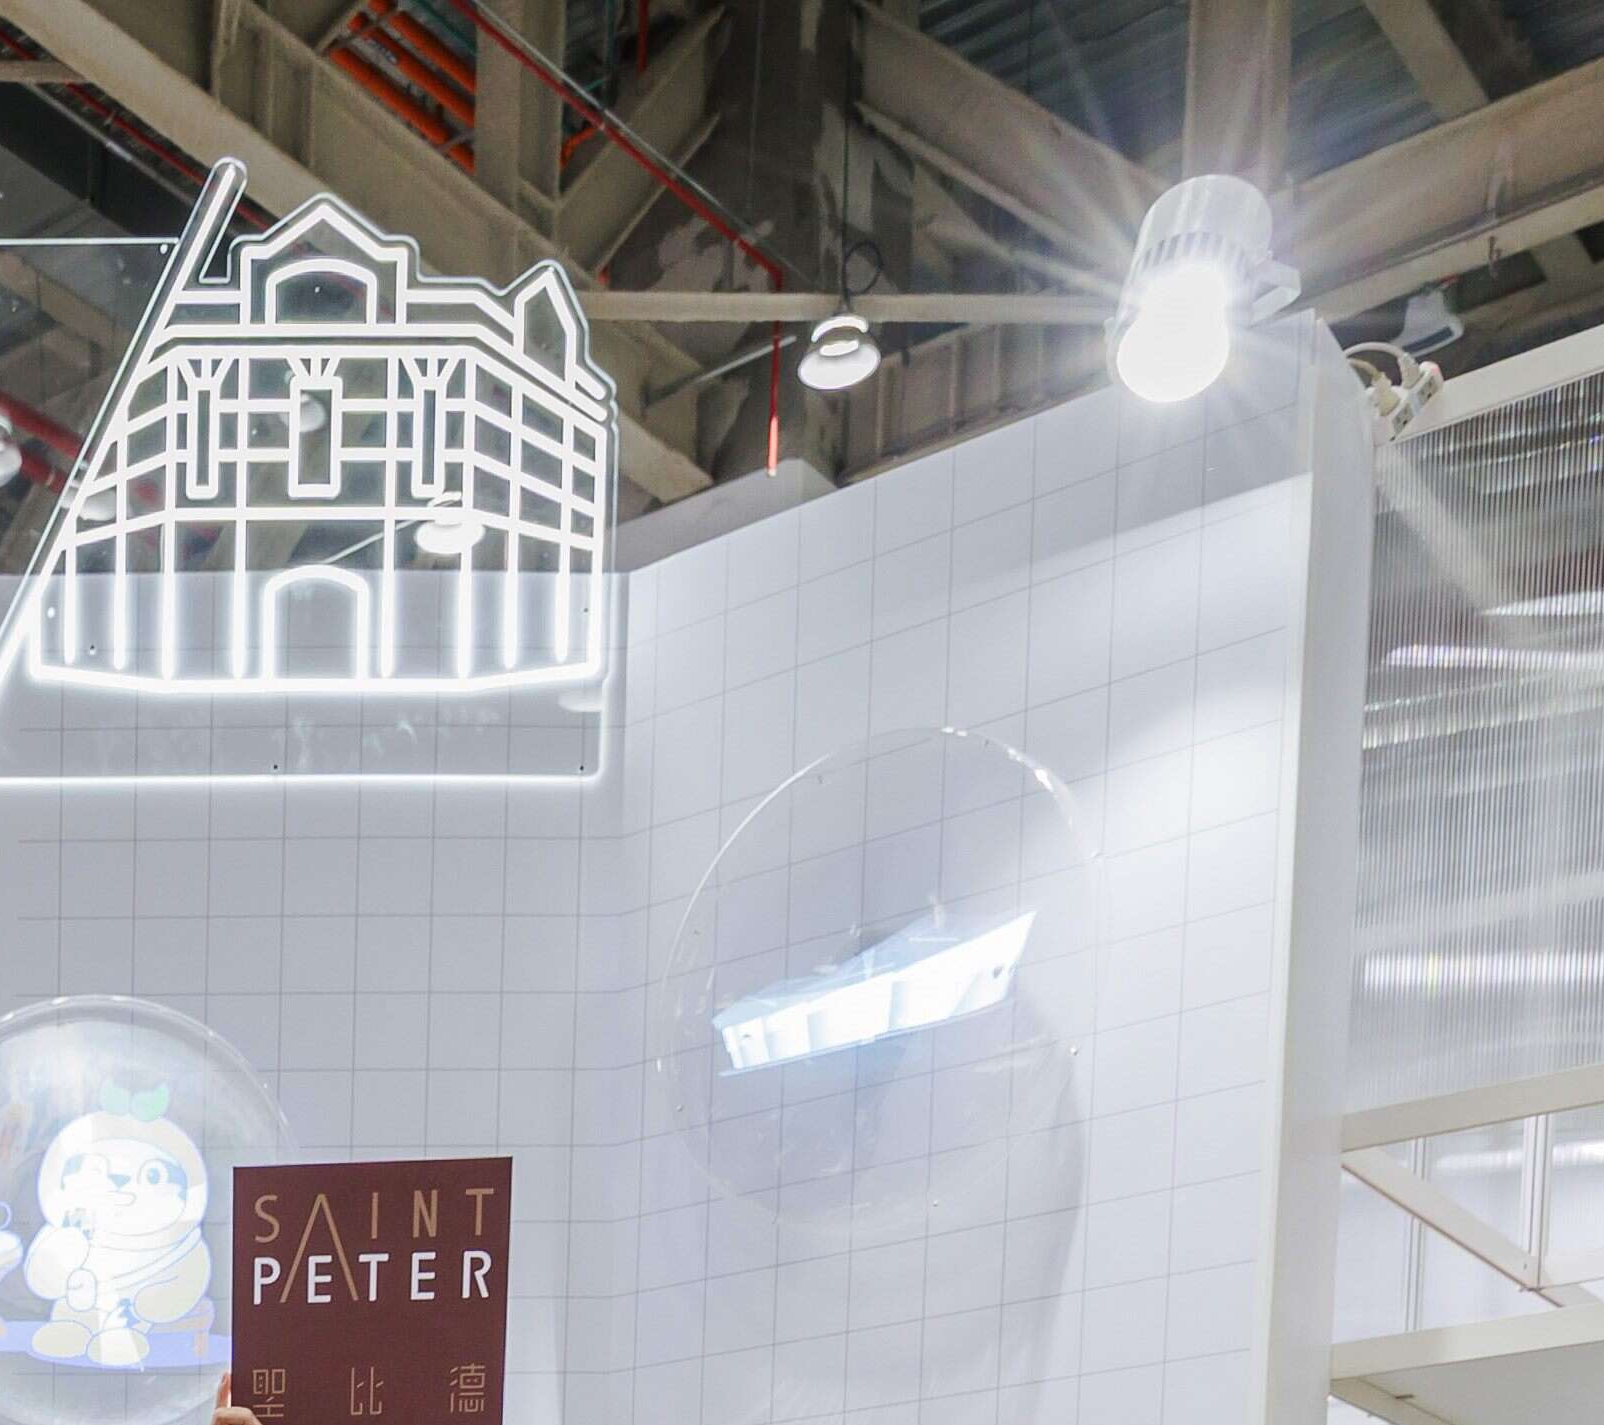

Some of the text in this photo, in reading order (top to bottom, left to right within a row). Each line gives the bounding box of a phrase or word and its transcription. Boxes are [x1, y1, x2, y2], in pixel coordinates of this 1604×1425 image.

[252, 1249, 493, 1306] PETER
[251, 1361, 487, 1418] 聖比德
